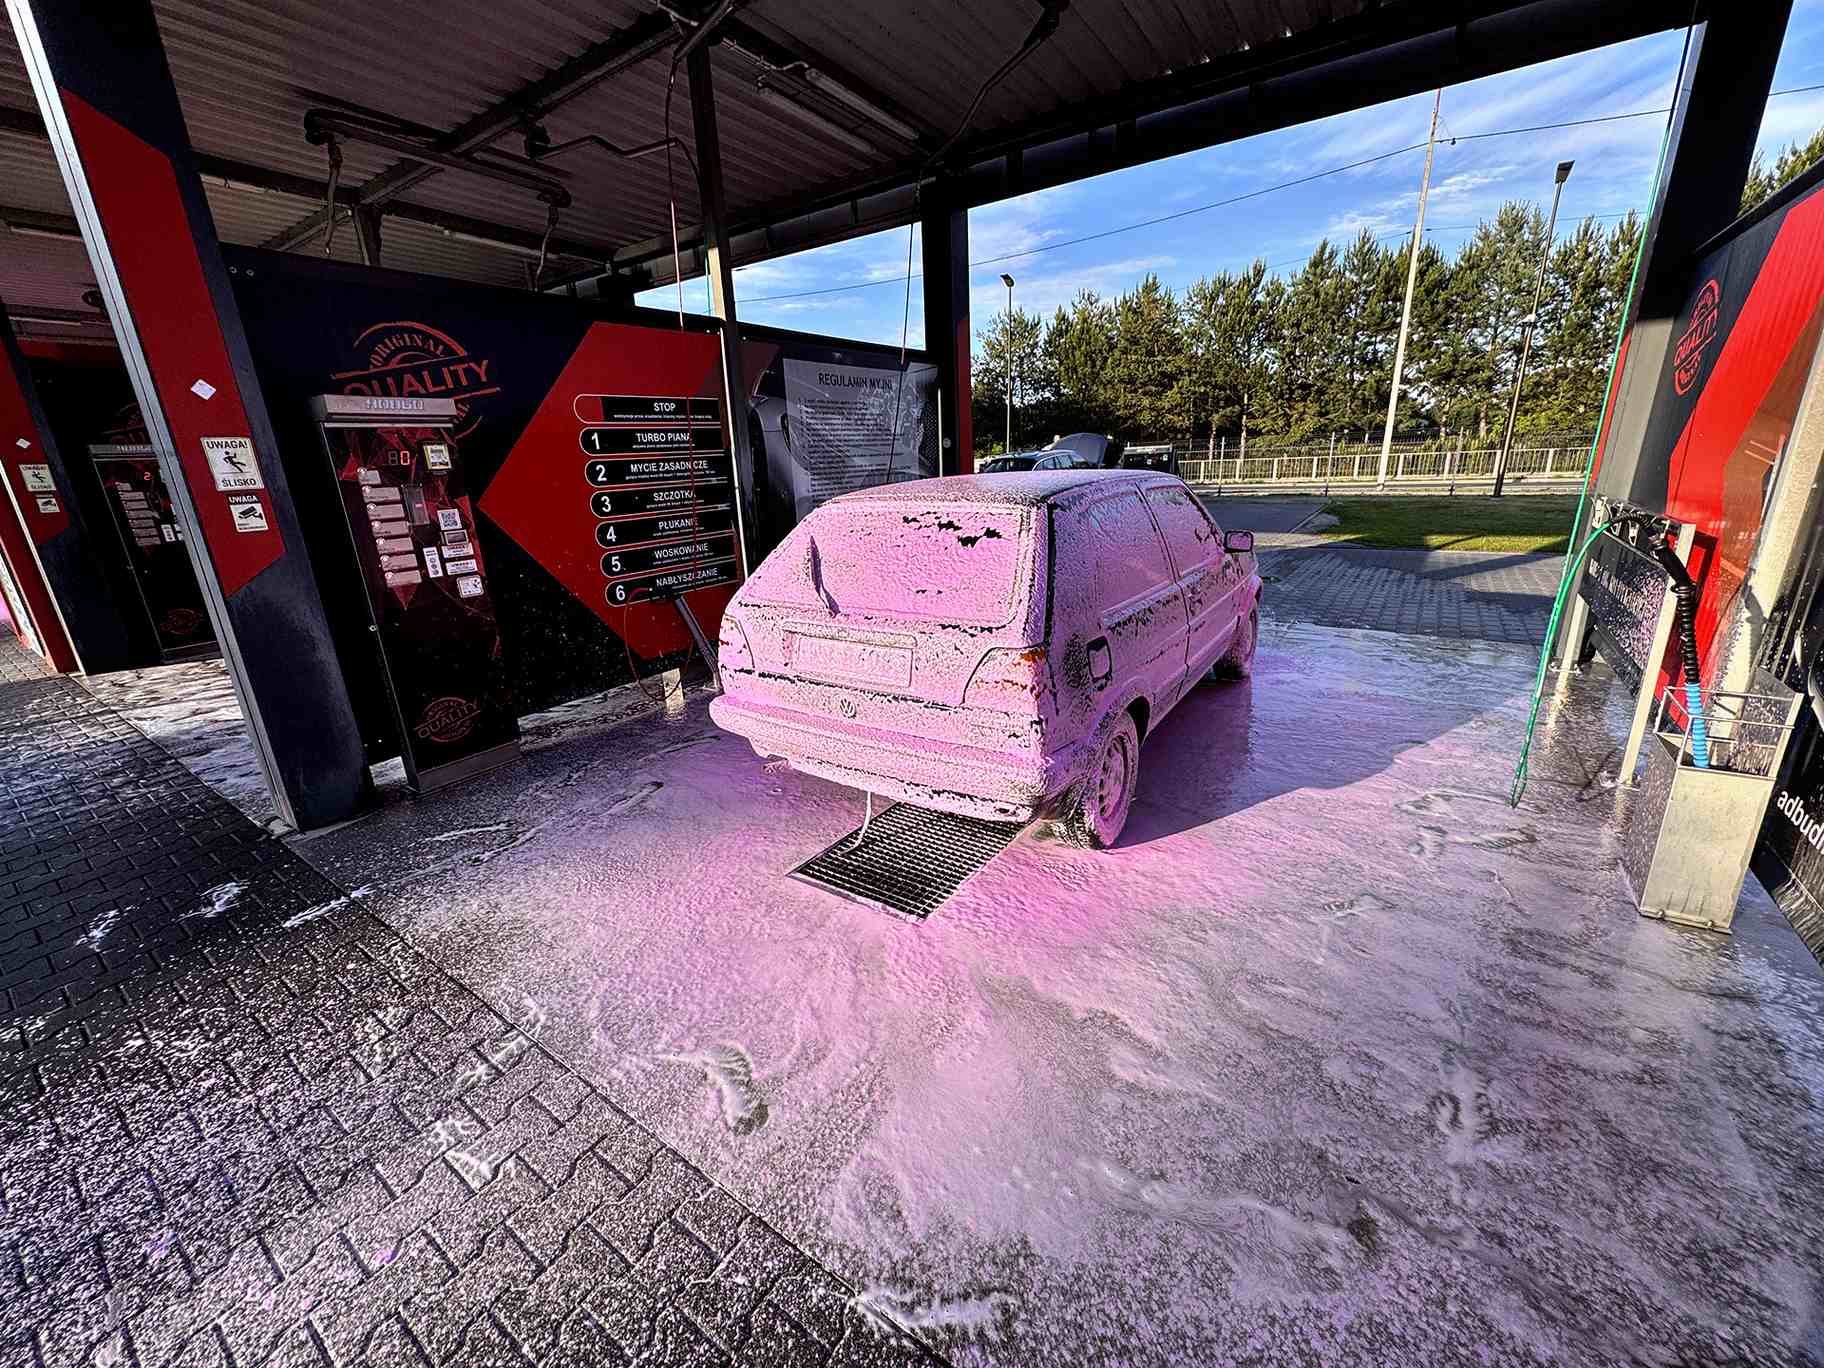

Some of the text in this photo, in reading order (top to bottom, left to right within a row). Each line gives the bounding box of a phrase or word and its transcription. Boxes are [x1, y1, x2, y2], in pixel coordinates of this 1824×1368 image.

[369, 334, 445, 369] ORIGINAL
[818, 373, 867, 387] REGULAMIN
[653, 402, 676, 412] STOP
[206, 440, 248, 450] UWAGA!
[591, 432, 600, 450] 1
[636, 433, 666, 442] TURBO
[595, 460, 708, 482] 2 MYCIE ZASADNCZE
[222, 477, 256, 488] ŚLISKO
[228, 494, 258, 504] UWAGA
[601, 490, 696, 512] 3 SZCZOTKA
[606, 526, 616, 542] 4
[611, 556, 621, 572] 5
[615, 584, 625, 600] 6
